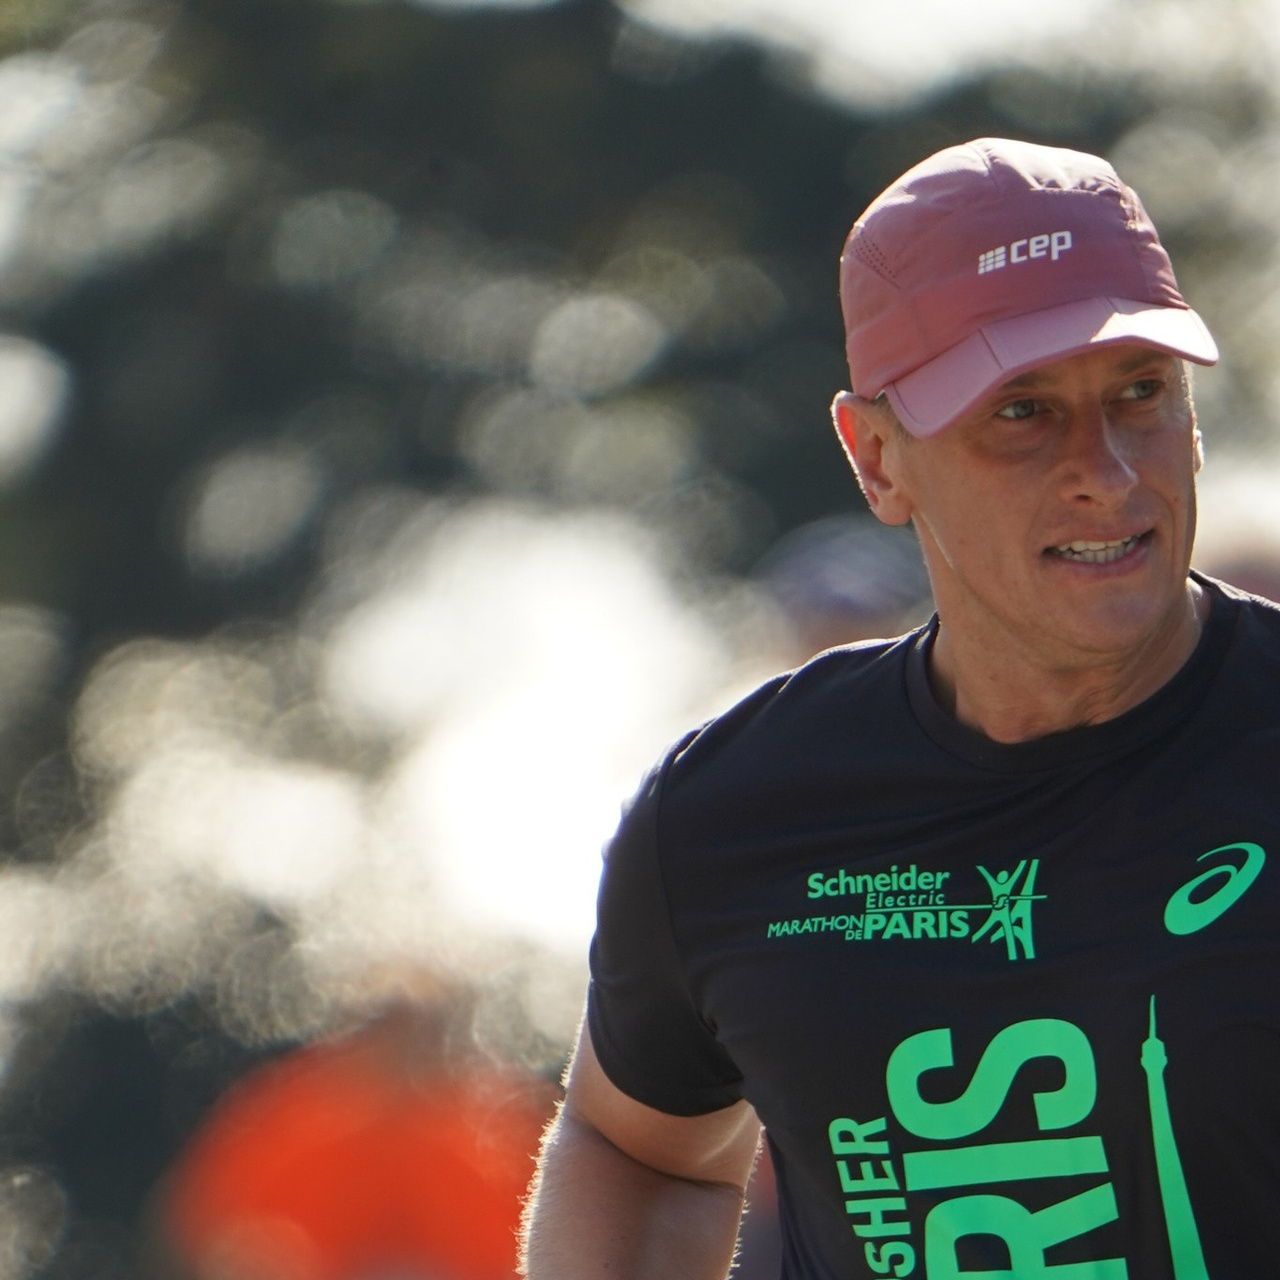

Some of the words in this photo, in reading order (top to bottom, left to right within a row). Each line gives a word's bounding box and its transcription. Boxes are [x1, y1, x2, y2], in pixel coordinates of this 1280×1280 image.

[1010, 230, 1072, 263] cep
[807, 864, 950, 898] Schneider
[865, 892, 945, 908] Electric
[767, 914, 864, 938] MARATHON
[845, 929, 862, 940] DE
[863, 911, 970, 940] PARIS
